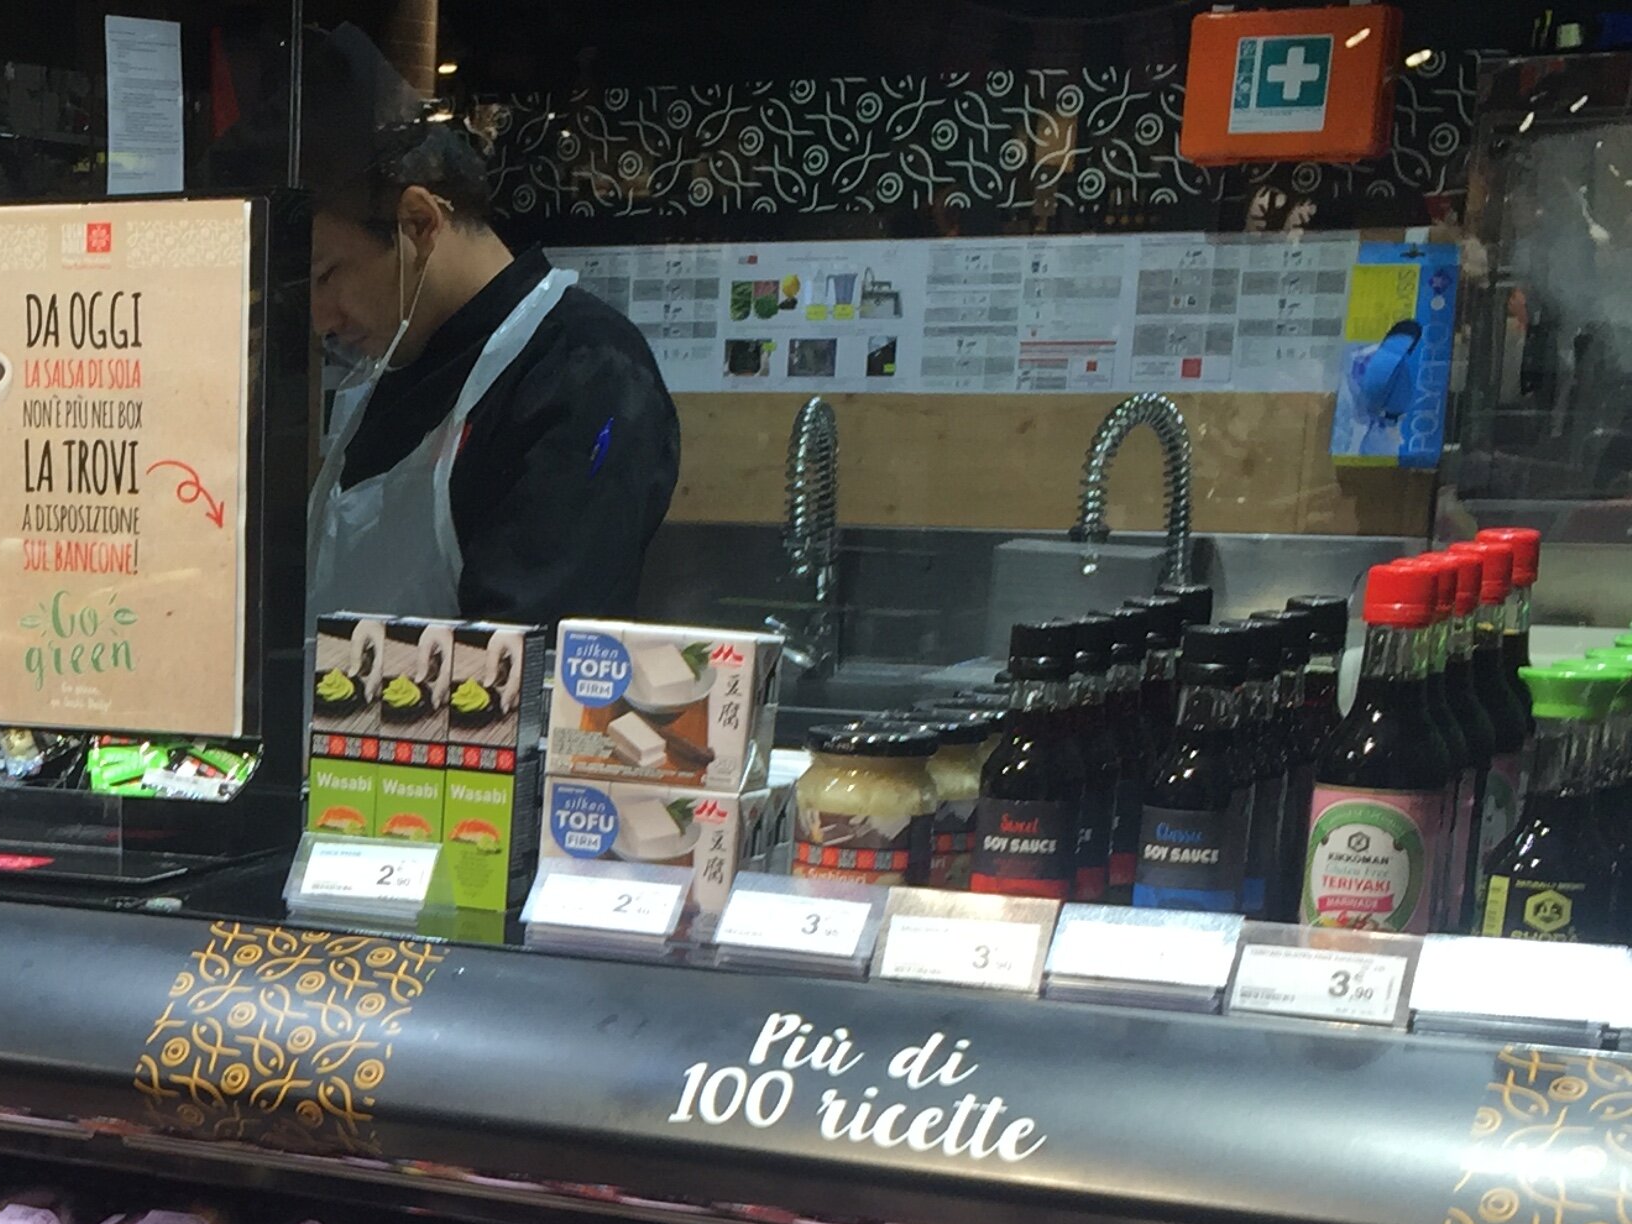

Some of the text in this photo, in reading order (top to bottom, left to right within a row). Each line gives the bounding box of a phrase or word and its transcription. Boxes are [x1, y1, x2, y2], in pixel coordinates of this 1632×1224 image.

[25, 290, 143, 350] DA OGGI
[24, 358, 142, 389] LA SALSA DI SOIA
[23, 394, 144, 430] NON È PIÙ NEI BOX
[24, 438, 140, 496] LA TROVI
[21, 503, 141, 535] A DISPOSIZIONE
[23, 538, 139, 576] SUL BANCONE!
[51, 590, 99, 638] Go
[576, 642, 619, 659] silken
[25, 639, 136, 692] green
[567, 657, 628, 681] TOFU
[578, 682, 611, 696] FIRM
[316, 771, 373, 792] Wasabi
[381, 778, 438, 800] Wasabi
[448, 782, 508, 805] Wasabi
[564, 796, 607, 812] silken
[555, 810, 615, 833] TOFU
[567, 835, 599, 849] FIRM
[983, 834, 1058, 855] SOY SAUCE
[1143, 843, 1220, 864] SOY SAUCE
[1328, 851, 1390, 865] KIKKOMAN
[376, 864, 395, 886] 2
[1321, 875, 1393, 893] TERIYAKI
[612, 894, 633, 914] 2
[800, 913, 822, 936] 3
[971, 944, 992, 969] 3
[1328, 969, 1352, 998] 3
[748, 1012, 980, 1090] Più di
[668, 1061, 1048, 1162] 100 ricette
